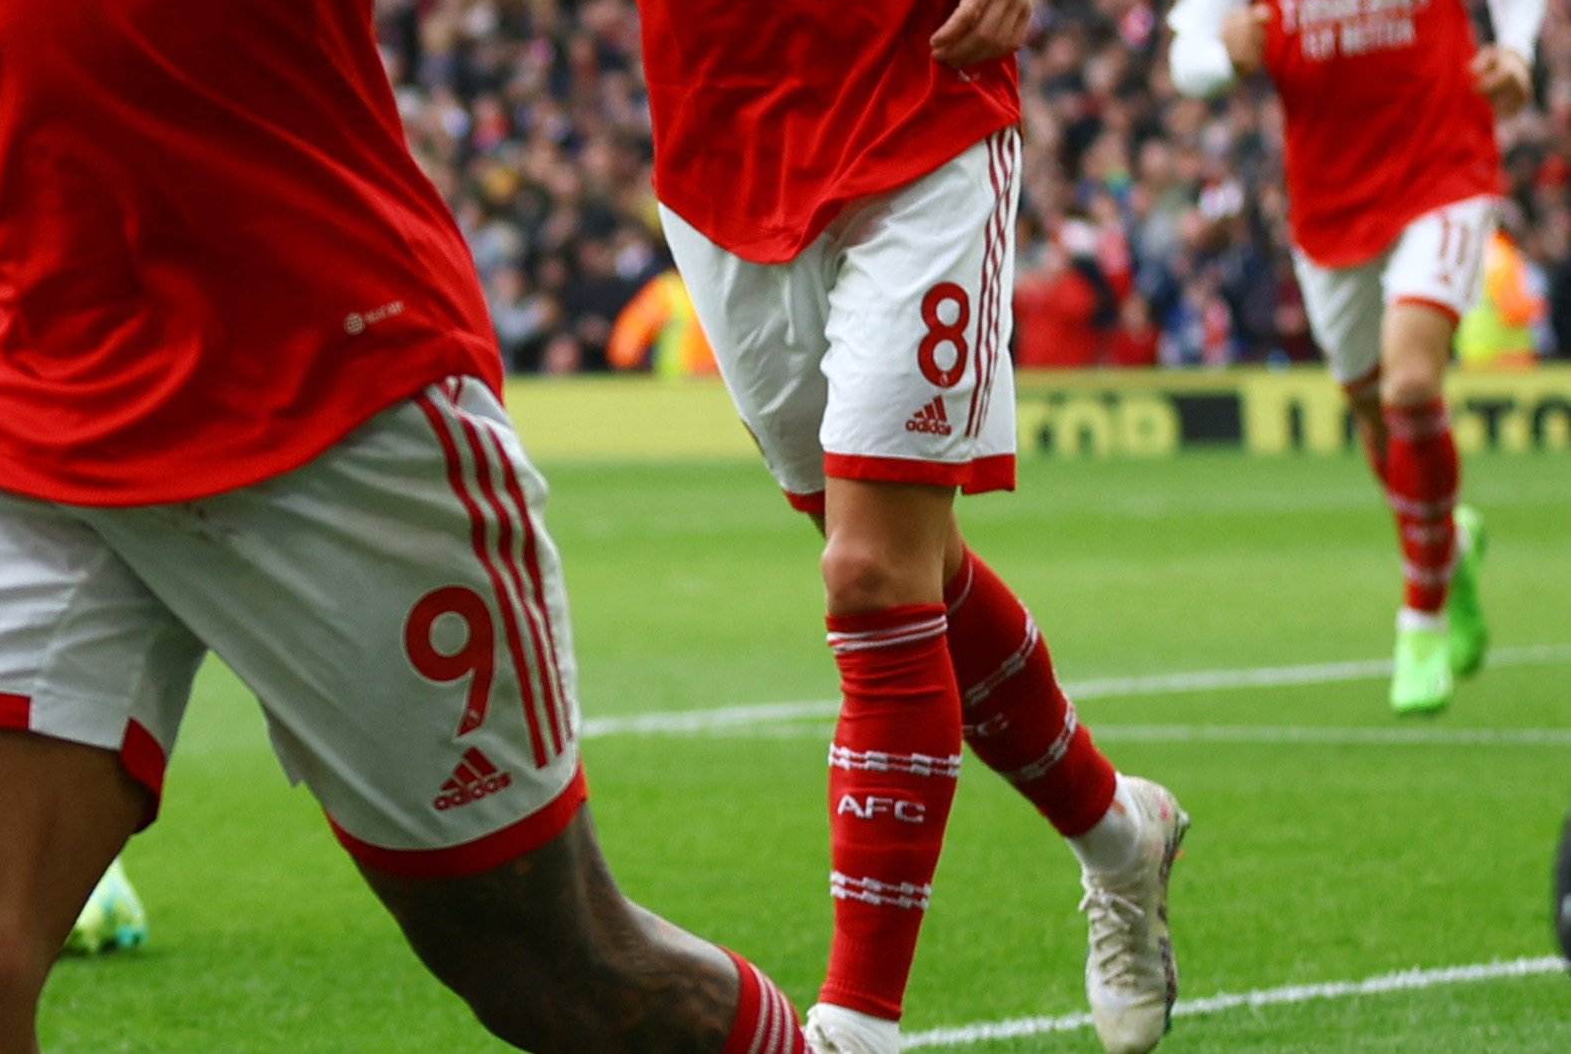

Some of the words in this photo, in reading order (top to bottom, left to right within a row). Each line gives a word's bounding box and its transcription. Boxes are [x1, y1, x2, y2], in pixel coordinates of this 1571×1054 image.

[917, 280, 971, 389] 8
[403, 584, 495, 741] 9
[432, 771, 513, 812] adidas
[837, 794, 926, 823] AFC
